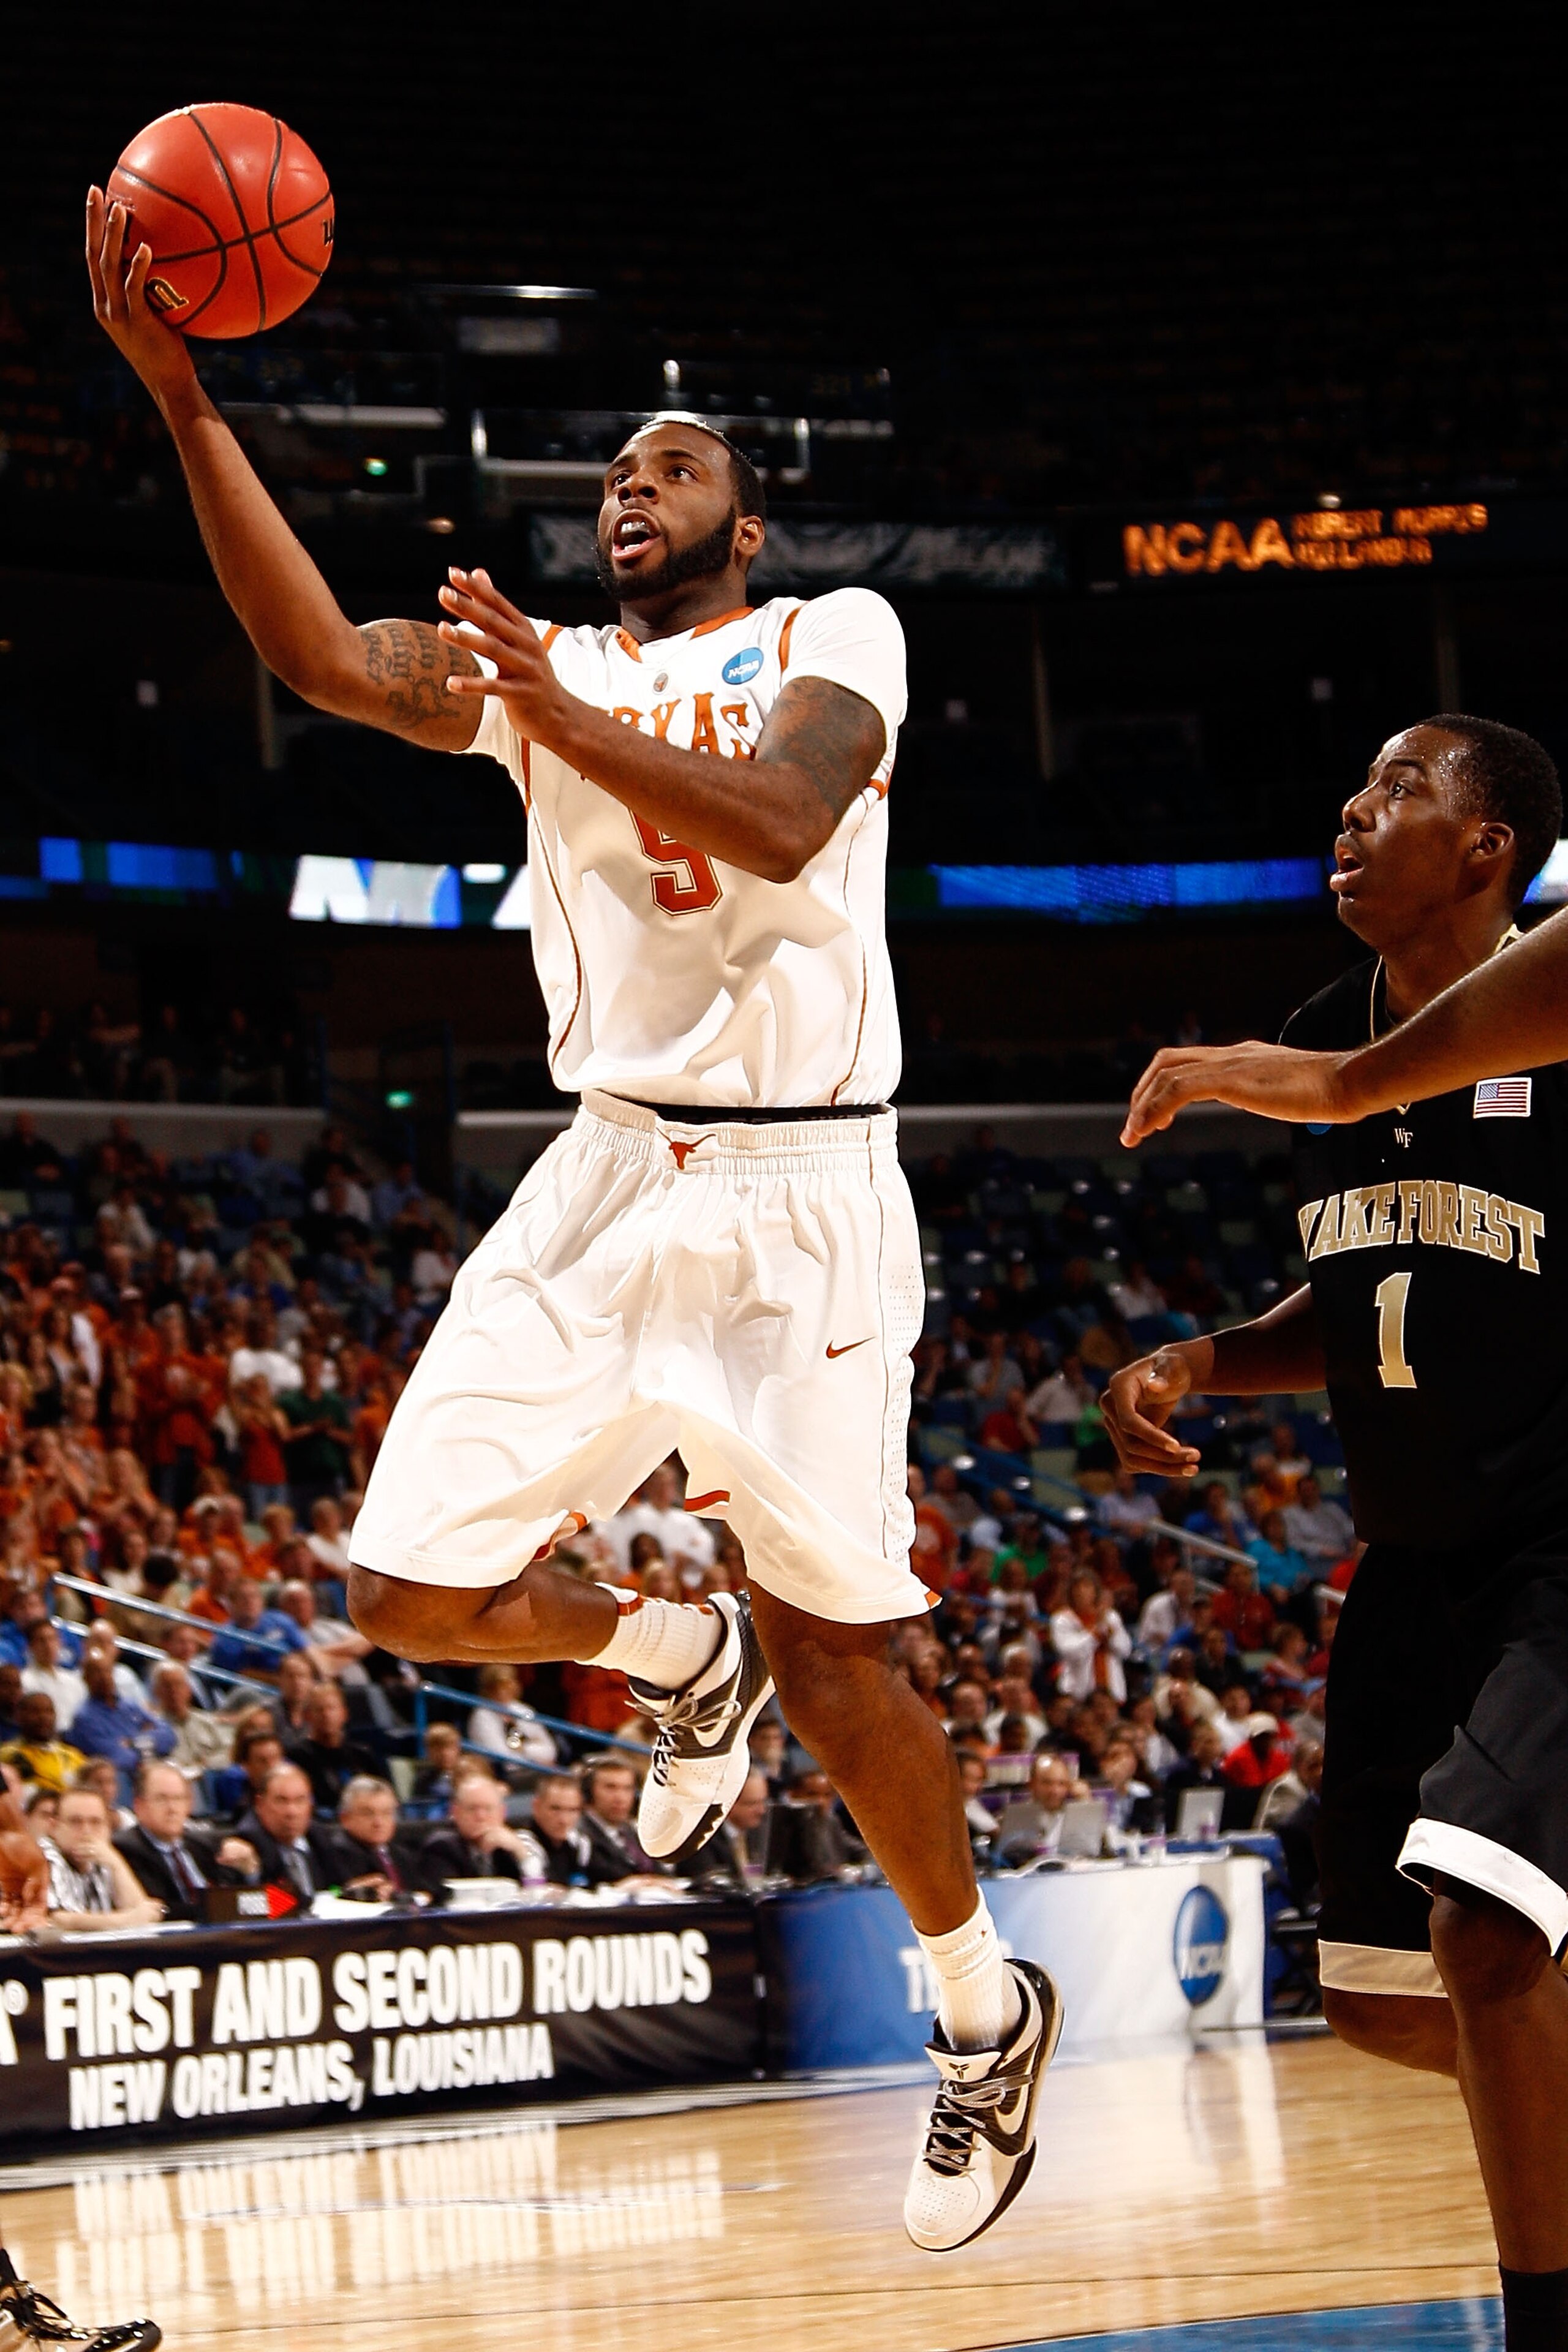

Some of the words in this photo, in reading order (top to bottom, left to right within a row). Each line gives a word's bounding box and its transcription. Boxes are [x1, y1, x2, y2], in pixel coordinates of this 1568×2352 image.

[1123, 518, 1295, 577] NCAA
[590, 692, 757, 761] XAS
[1394, 1128, 1414, 1148] WF
[1397, 1180, 1546, 1275] FOREST
[1374, 1272, 1417, 1389] 1
[43, 1967, 202, 2061] FIRST
[211, 1956, 322, 2045] AND
[332, 1941, 524, 2034] SECOND
[531, 1929, 712, 2015] ROUNDS
[67, 2059, 167, 2131] NEW
[172, 2040, 365, 2119] ORLEANS,
[372, 2022, 556, 2097] LOUISIANA
